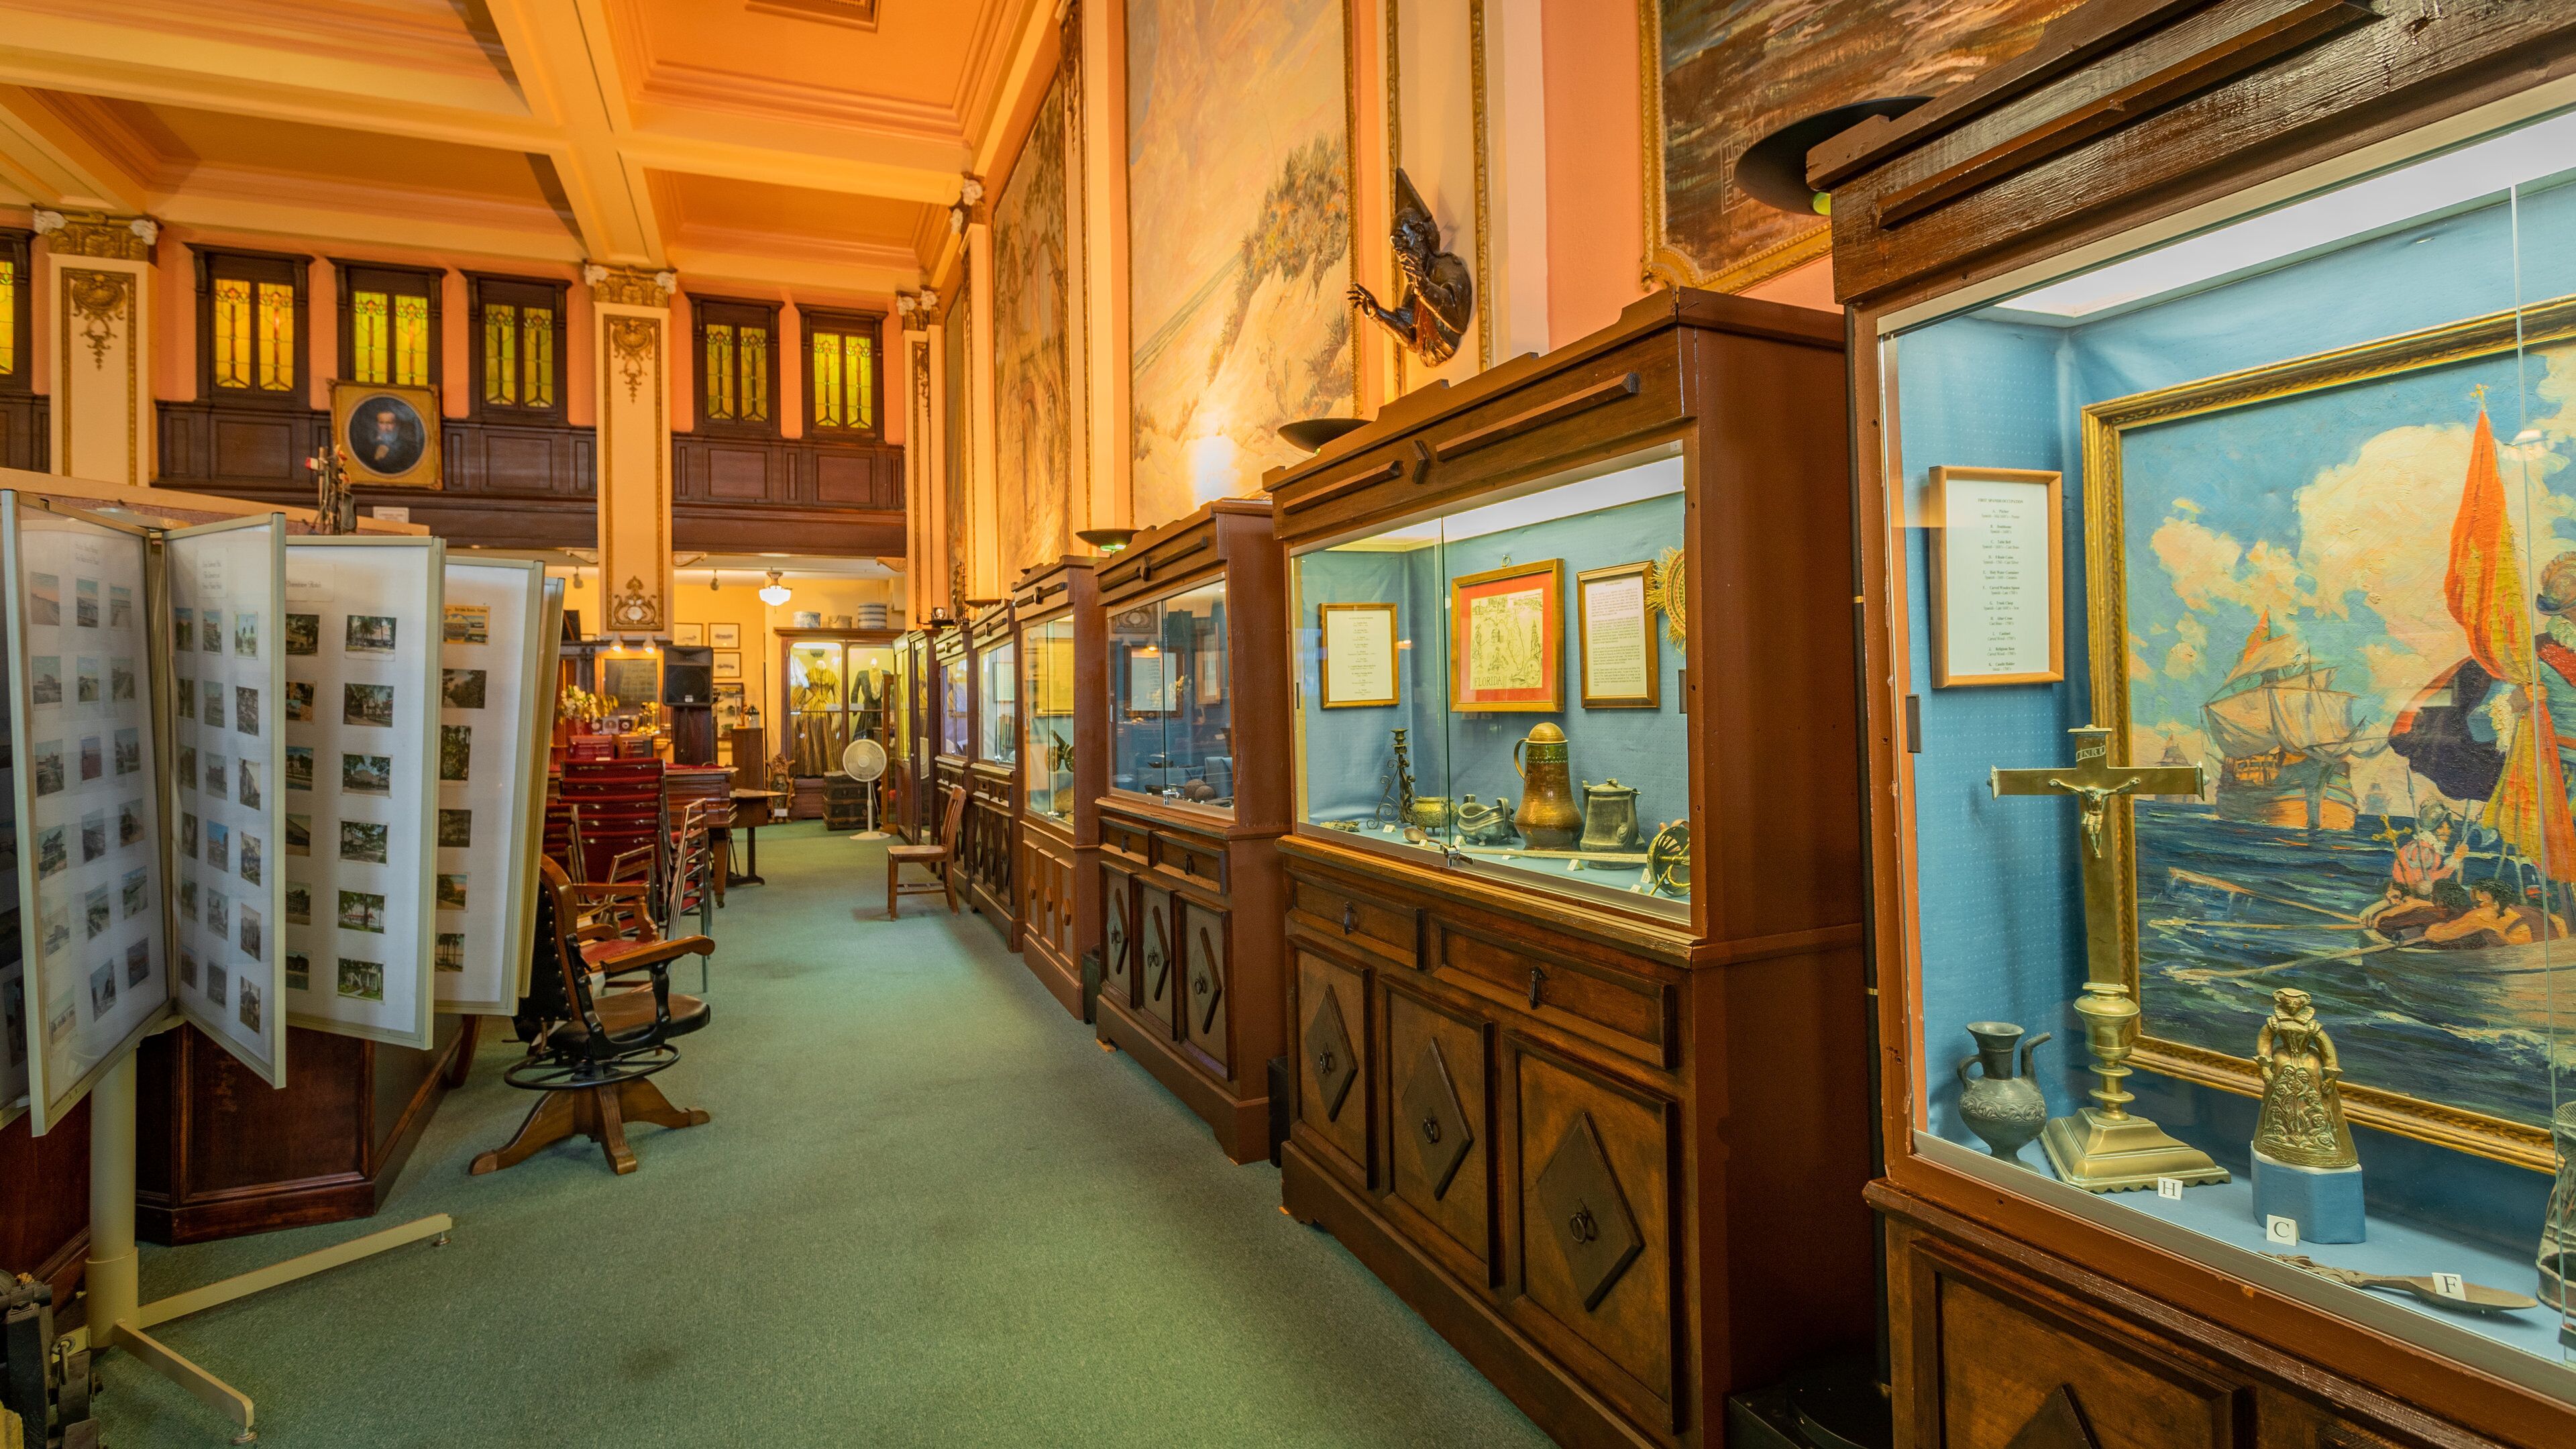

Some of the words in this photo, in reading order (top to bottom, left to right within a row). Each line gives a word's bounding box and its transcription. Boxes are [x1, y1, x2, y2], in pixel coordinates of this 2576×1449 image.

[1474, 676, 1503, 687] FLORIDA
[2079, 747, 2105, 758] INRI
[2161, 1181, 2176, 1197] H
[2273, 1221, 2290, 1238] C
[2442, 1275, 2459, 1293] F
